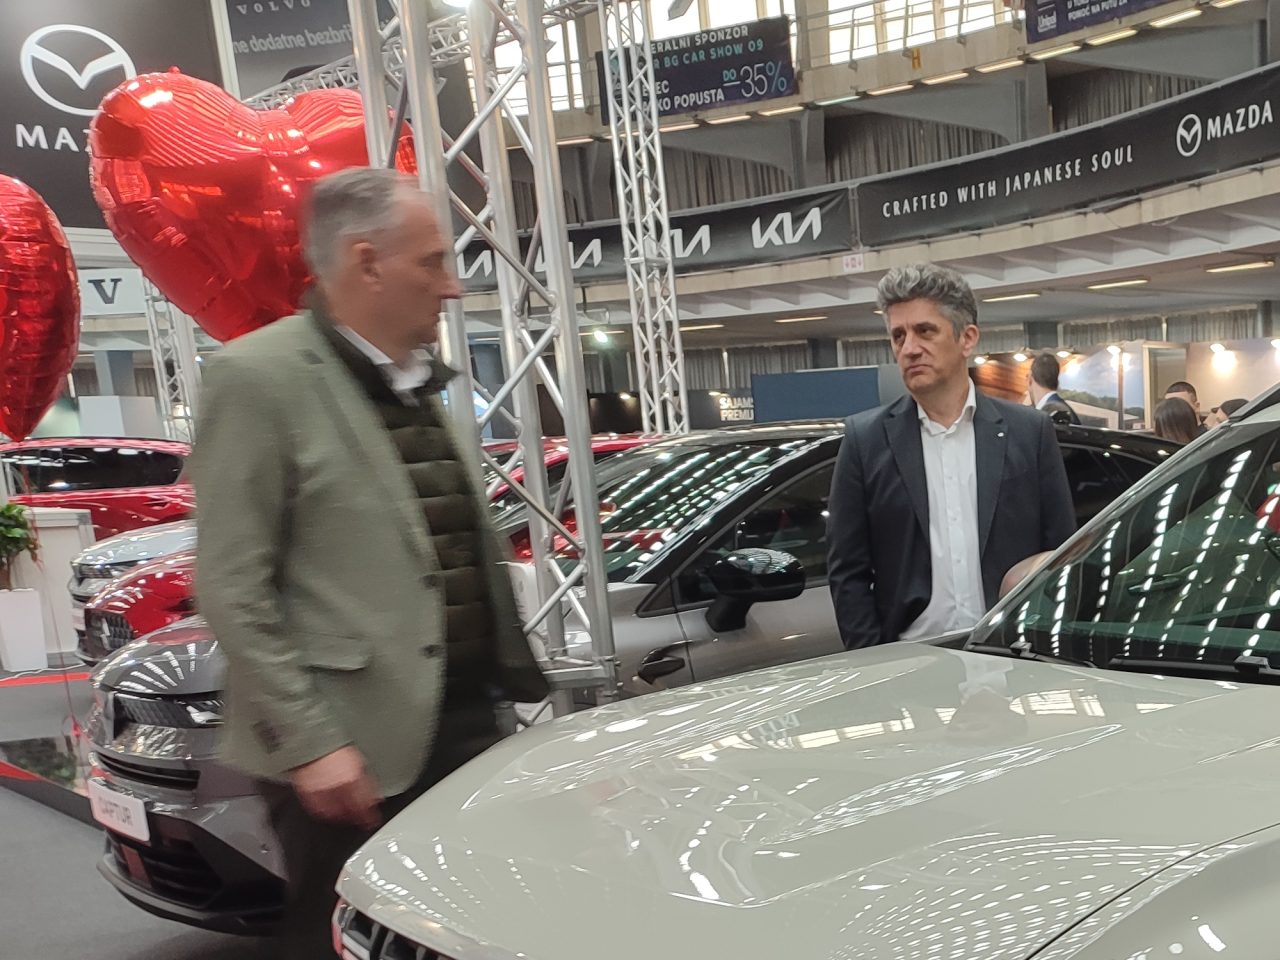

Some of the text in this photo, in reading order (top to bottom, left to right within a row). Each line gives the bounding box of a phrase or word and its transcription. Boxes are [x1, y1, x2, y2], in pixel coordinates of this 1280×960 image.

[249, 32, 306, 53] dodatne
[304, 25, 352, 47] bezbri
[651, 25, 748, 55] ERALNI SPONZOR
[664, 56, 679, 67] BG
[683, 50, 705, 64] CAR
[710, 44, 743, 60] SHOW
[748, 38, 764, 52] 09
[674, 88, 725, 109] POPUSTA
[1206, 100, 1274, 142] MAZDA
[882, 144, 1134, 219] CRAFTED WITH JAPANESE SOUL
[752, 206, 822, 249] KIA
